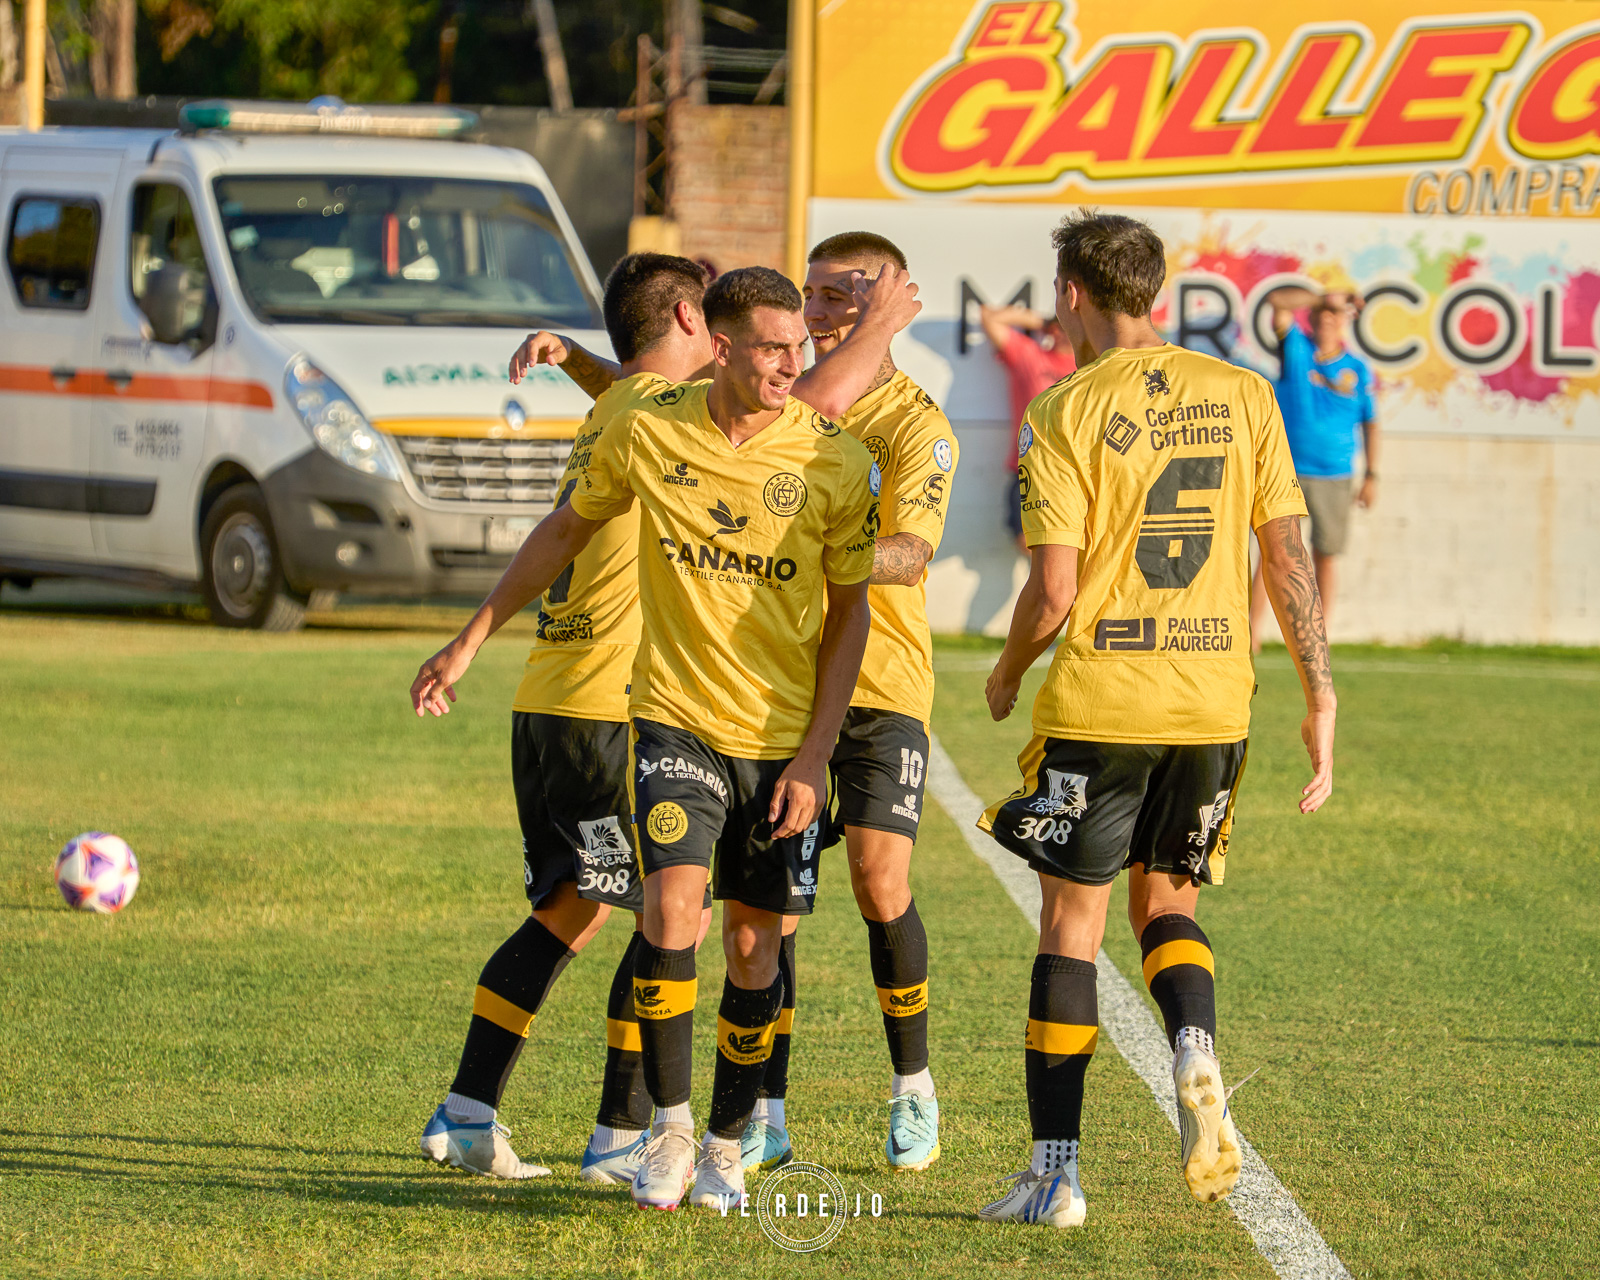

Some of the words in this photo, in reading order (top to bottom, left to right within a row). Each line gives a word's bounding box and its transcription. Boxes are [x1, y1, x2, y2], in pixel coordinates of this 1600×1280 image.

[966, 2, 1064, 50] EL
[1145, 399, 1230, 428] Cerámica
[1150, 423, 1234, 451] Cortines
[663, 474, 699, 488] ANGEXIA
[1135, 455, 1226, 590] 6
[659, 537, 798, 582] CANARIO
[680, 566, 714, 581] TEXTILE
[717, 573, 765, 587] CANARIO
[1168, 617, 1230, 634] PALLETS
[1160, 634, 1233, 652] JAUREGUI
[660, 757, 728, 797] CANARIO
[899, 748, 924, 789] 10
[1013, 817, 1073, 845] 308
[577, 868, 631, 895] 308
[791, 884, 818, 897] ANGEX
